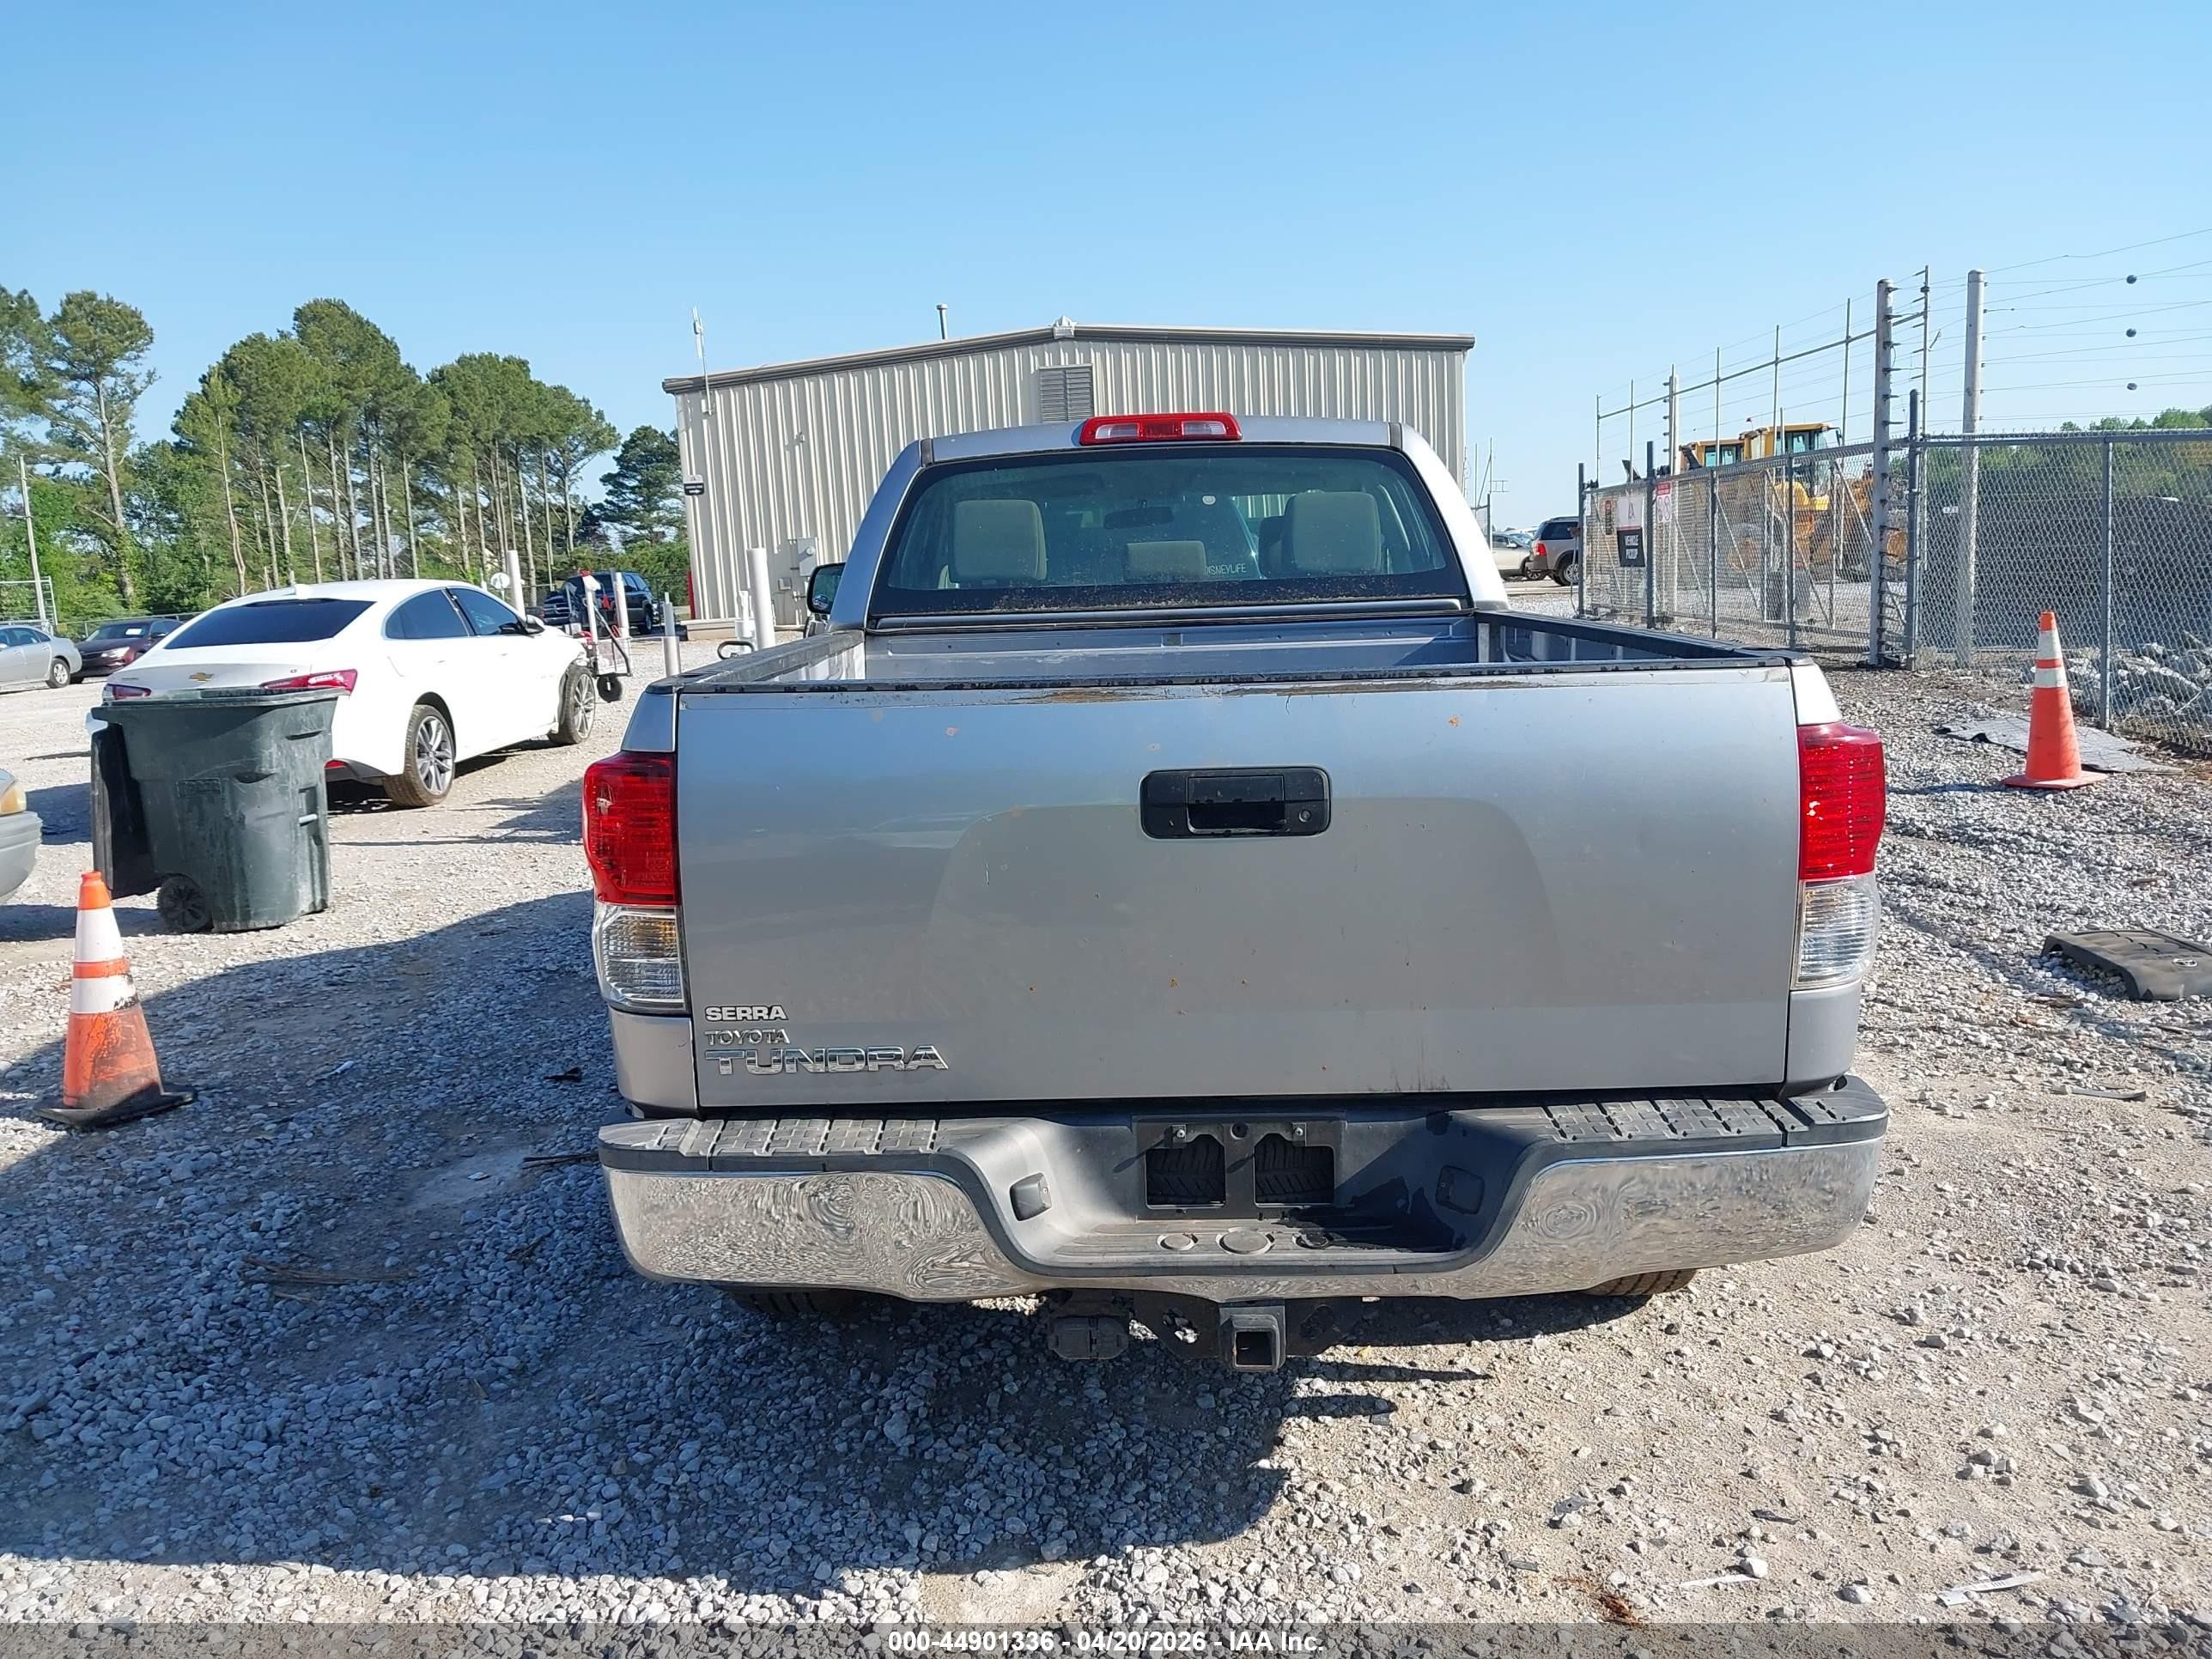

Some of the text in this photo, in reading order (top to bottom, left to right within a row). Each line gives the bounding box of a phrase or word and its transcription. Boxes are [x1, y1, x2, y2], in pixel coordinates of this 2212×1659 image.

[705, 1005, 788, 1021] SERRA
[704, 1028, 791, 1046] TOYOTA
[704, 1044, 949, 1075] TUNDRA
